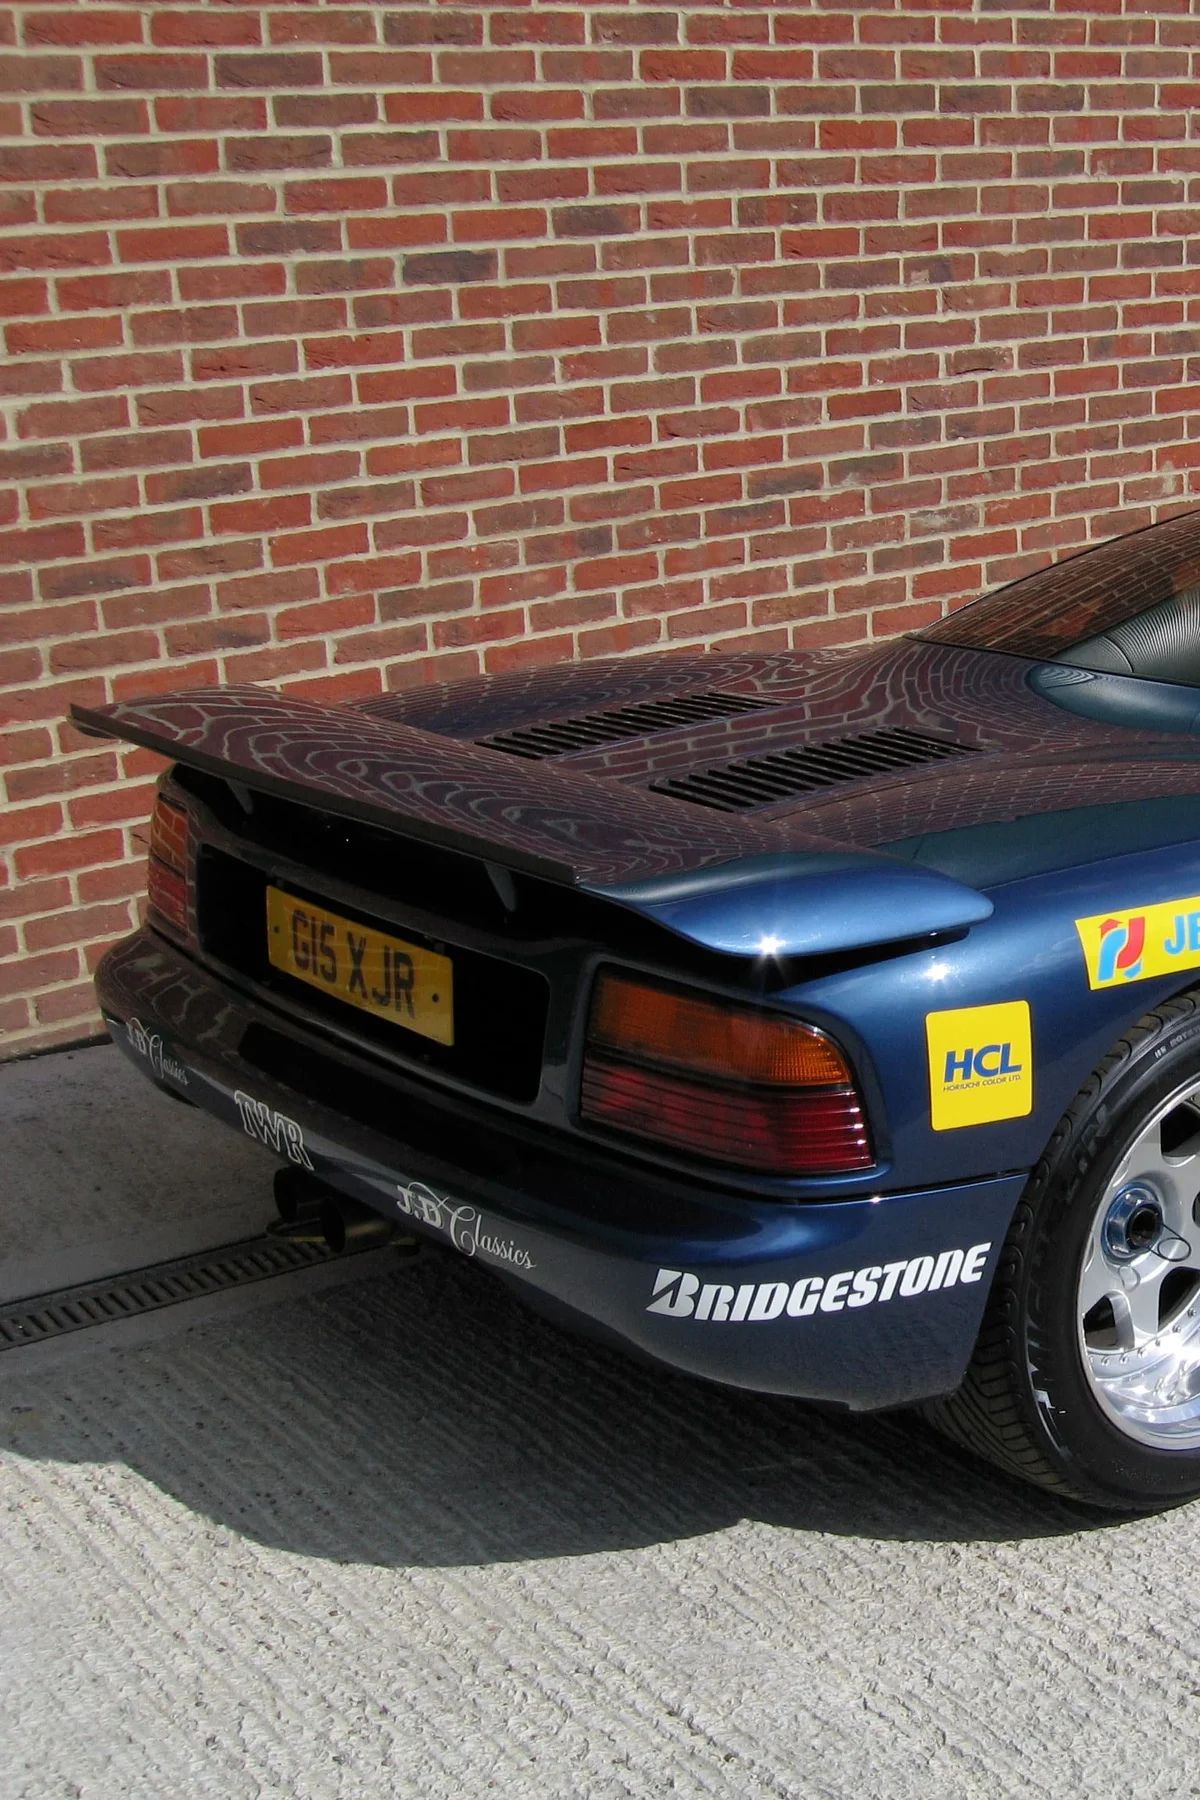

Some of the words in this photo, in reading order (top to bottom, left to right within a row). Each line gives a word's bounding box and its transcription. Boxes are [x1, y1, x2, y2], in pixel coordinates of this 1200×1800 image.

[346, 930, 369, 1000] X
[371, 943, 416, 1020] JR
[943, 1042, 1023, 1084] HCL
[982, 1077, 1007, 1087] COLOR
[234, 1090, 314, 1171] TWR
[449, 1205, 537, 1270] Classics
[645, 1242, 993, 1322] BRIDGESTONE
